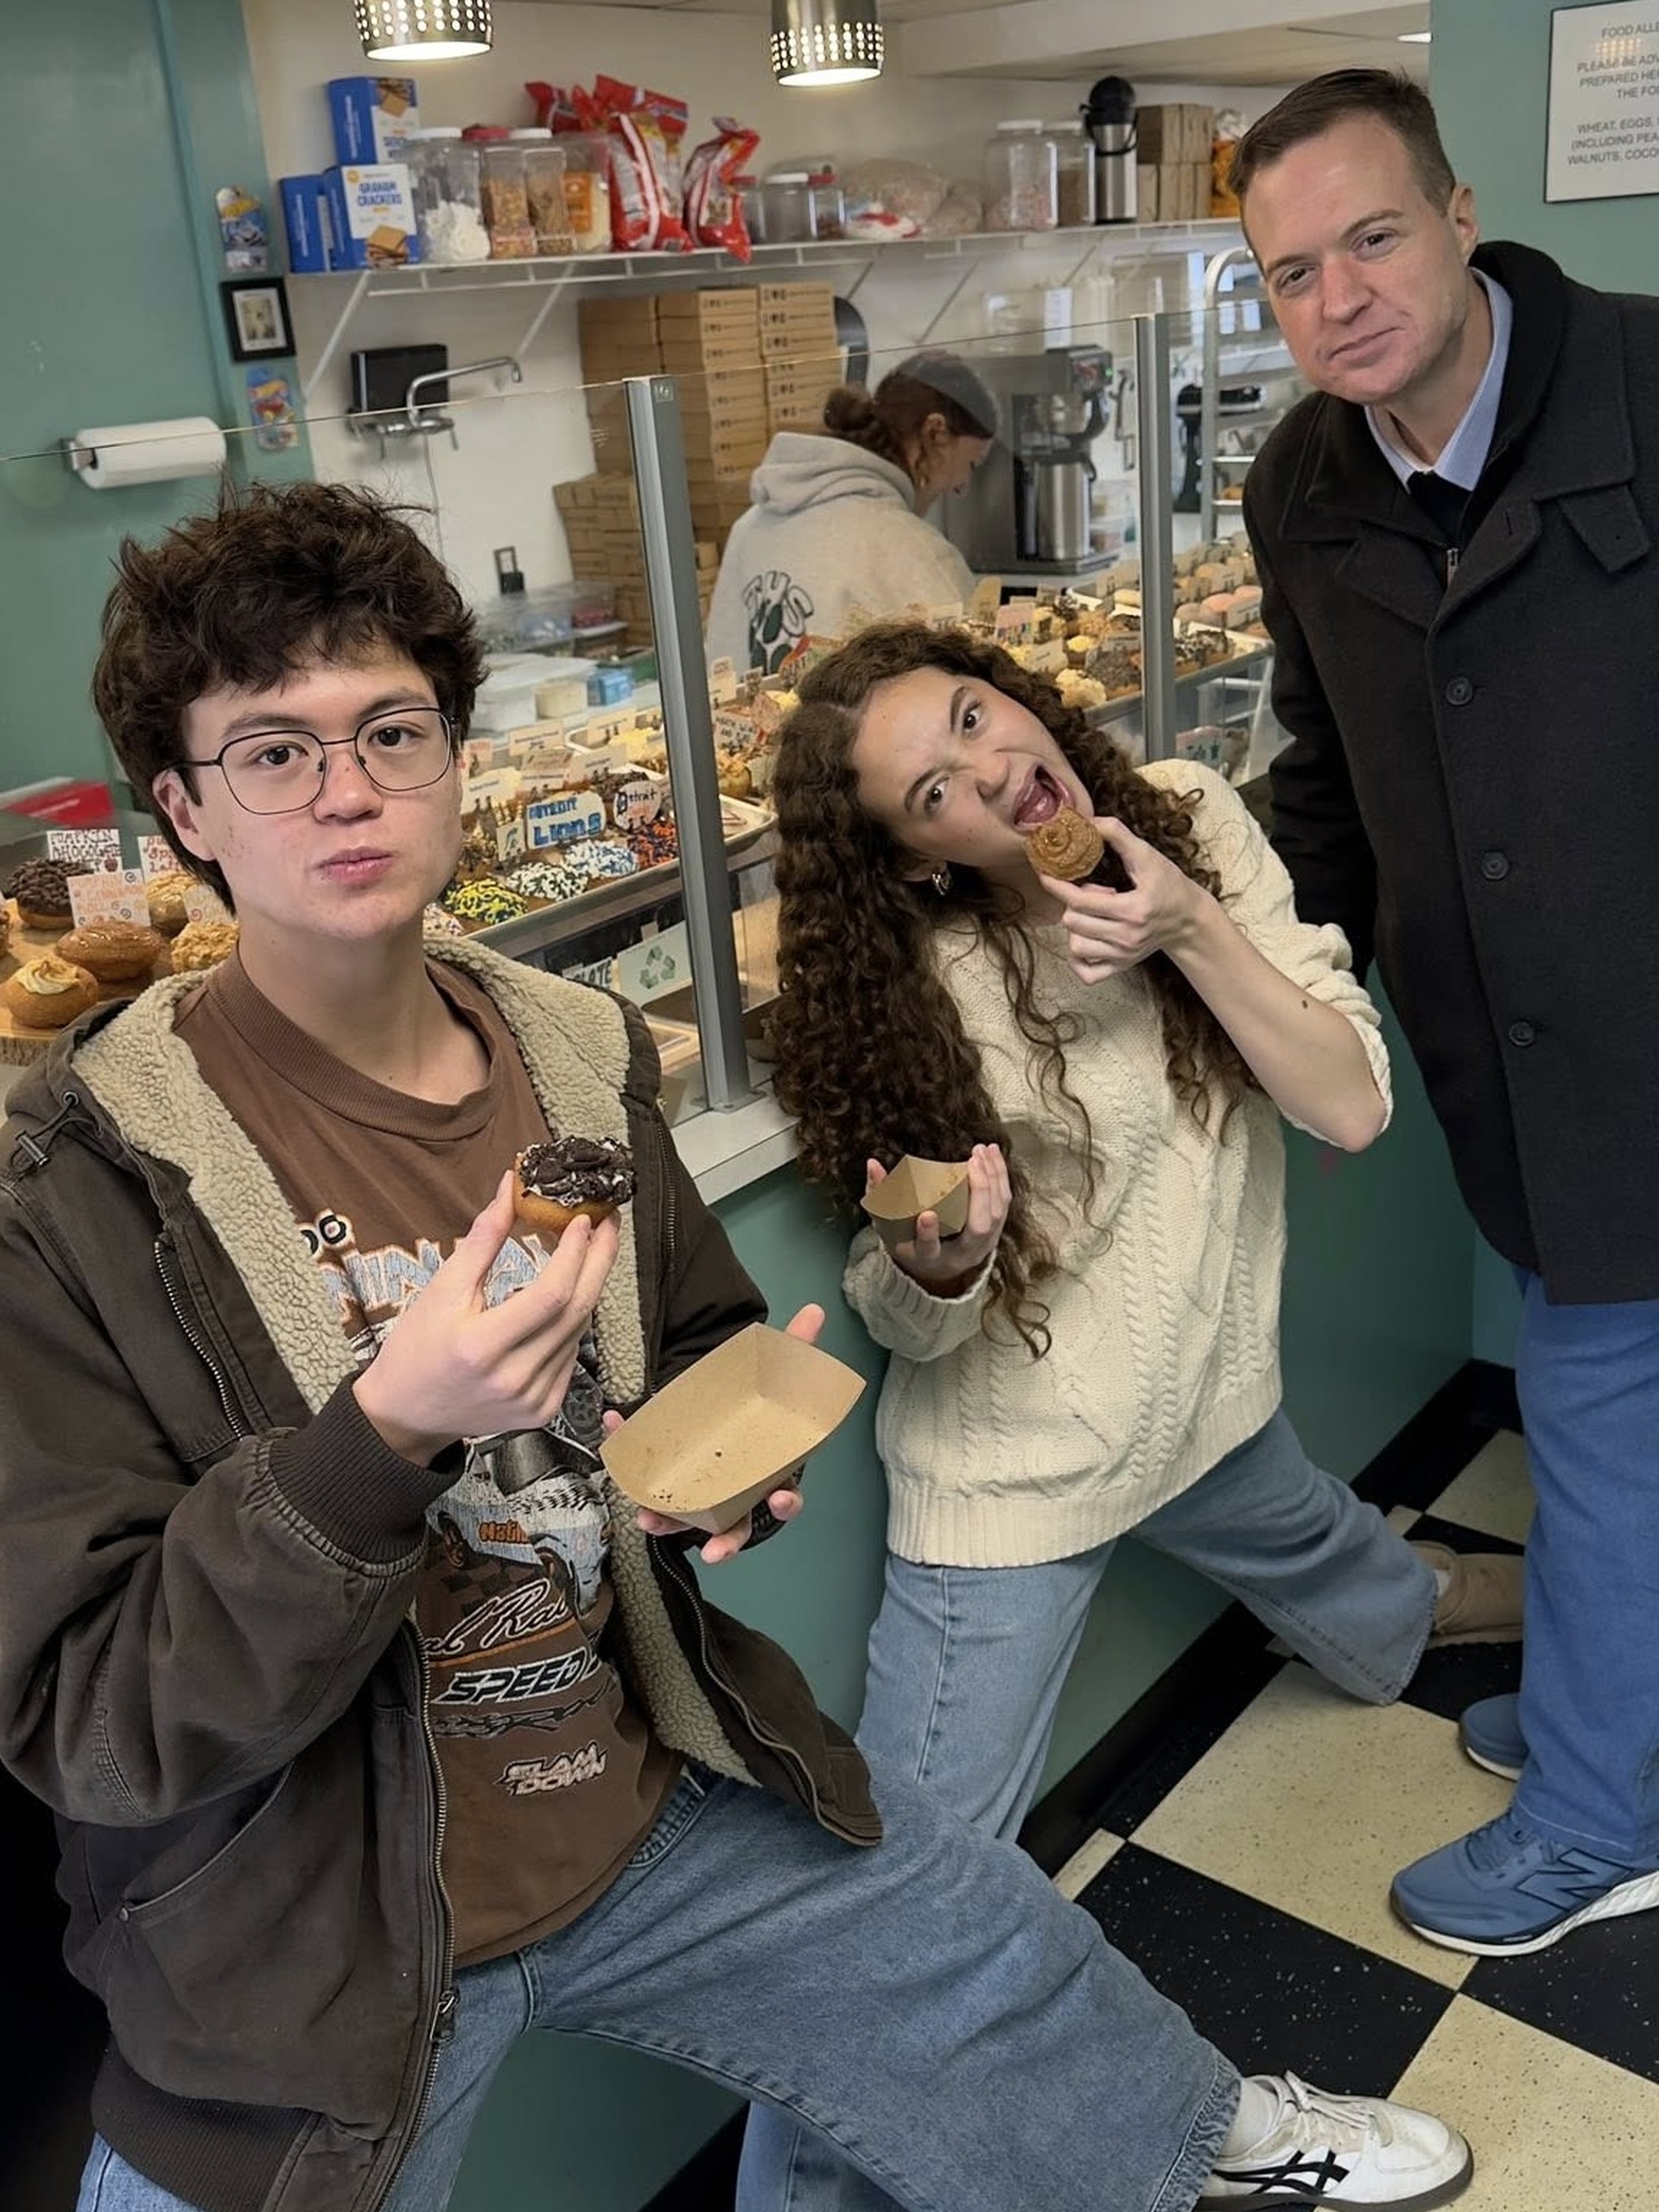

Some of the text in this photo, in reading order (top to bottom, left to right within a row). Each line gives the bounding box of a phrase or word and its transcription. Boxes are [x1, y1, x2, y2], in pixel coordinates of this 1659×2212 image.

[1601, 24, 1634, 38] FOOD
[1577, 58, 1620, 72] PLEASE
[1622, 55, 1637, 67] BE
[1580, 71, 1638, 87] PREPARED
[1616, 86, 1639, 99] THE
[1571, 133, 1634, 151] (INCLUDING
[359, 181, 397, 194] GRAHAM
[358, 194, 403, 207] CRACKERS
[533, 812, 601, 846] LIONS
[496, 1739, 601, 1783] SLAM
[508, 1751, 607, 1796] DOWN
